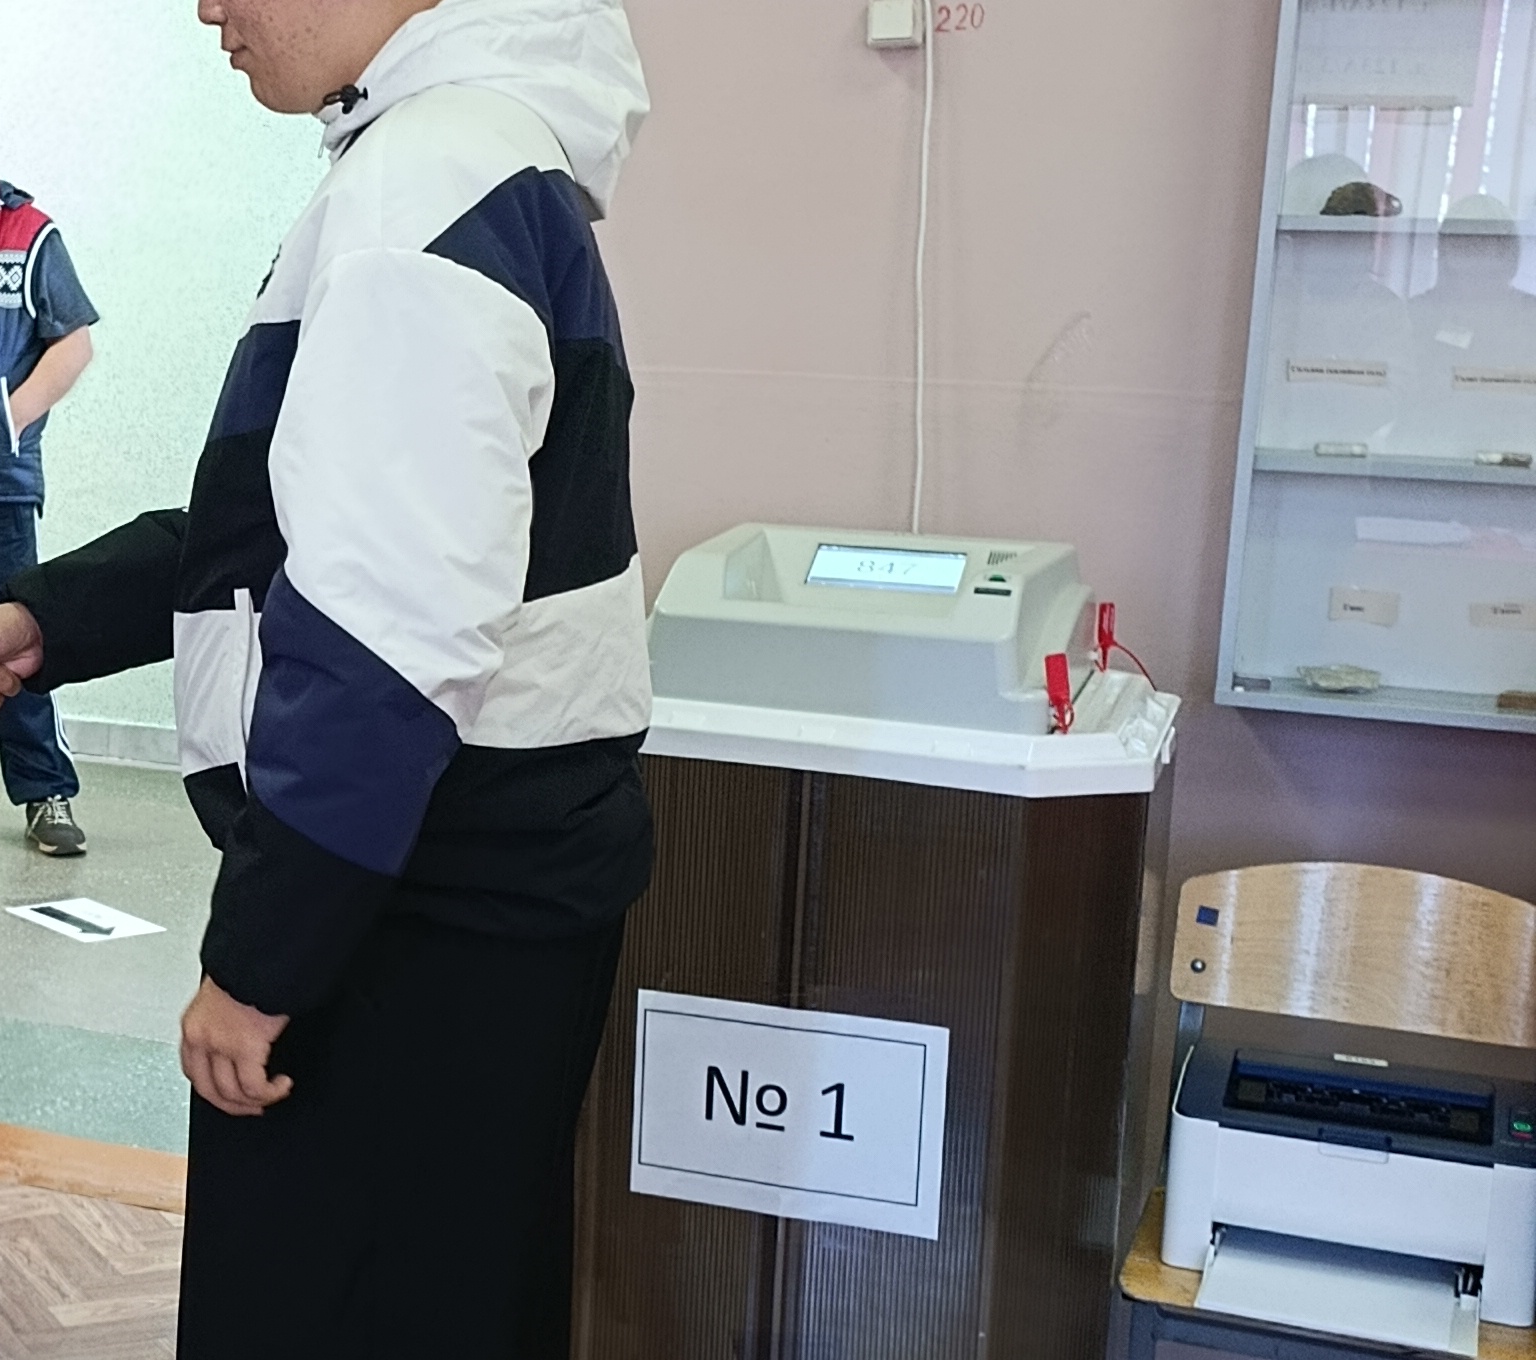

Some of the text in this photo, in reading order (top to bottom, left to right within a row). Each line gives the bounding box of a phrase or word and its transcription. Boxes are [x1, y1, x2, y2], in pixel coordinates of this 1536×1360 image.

[934, 2, 985, 33] 220
[705, 1065, 854, 1142] № 1
